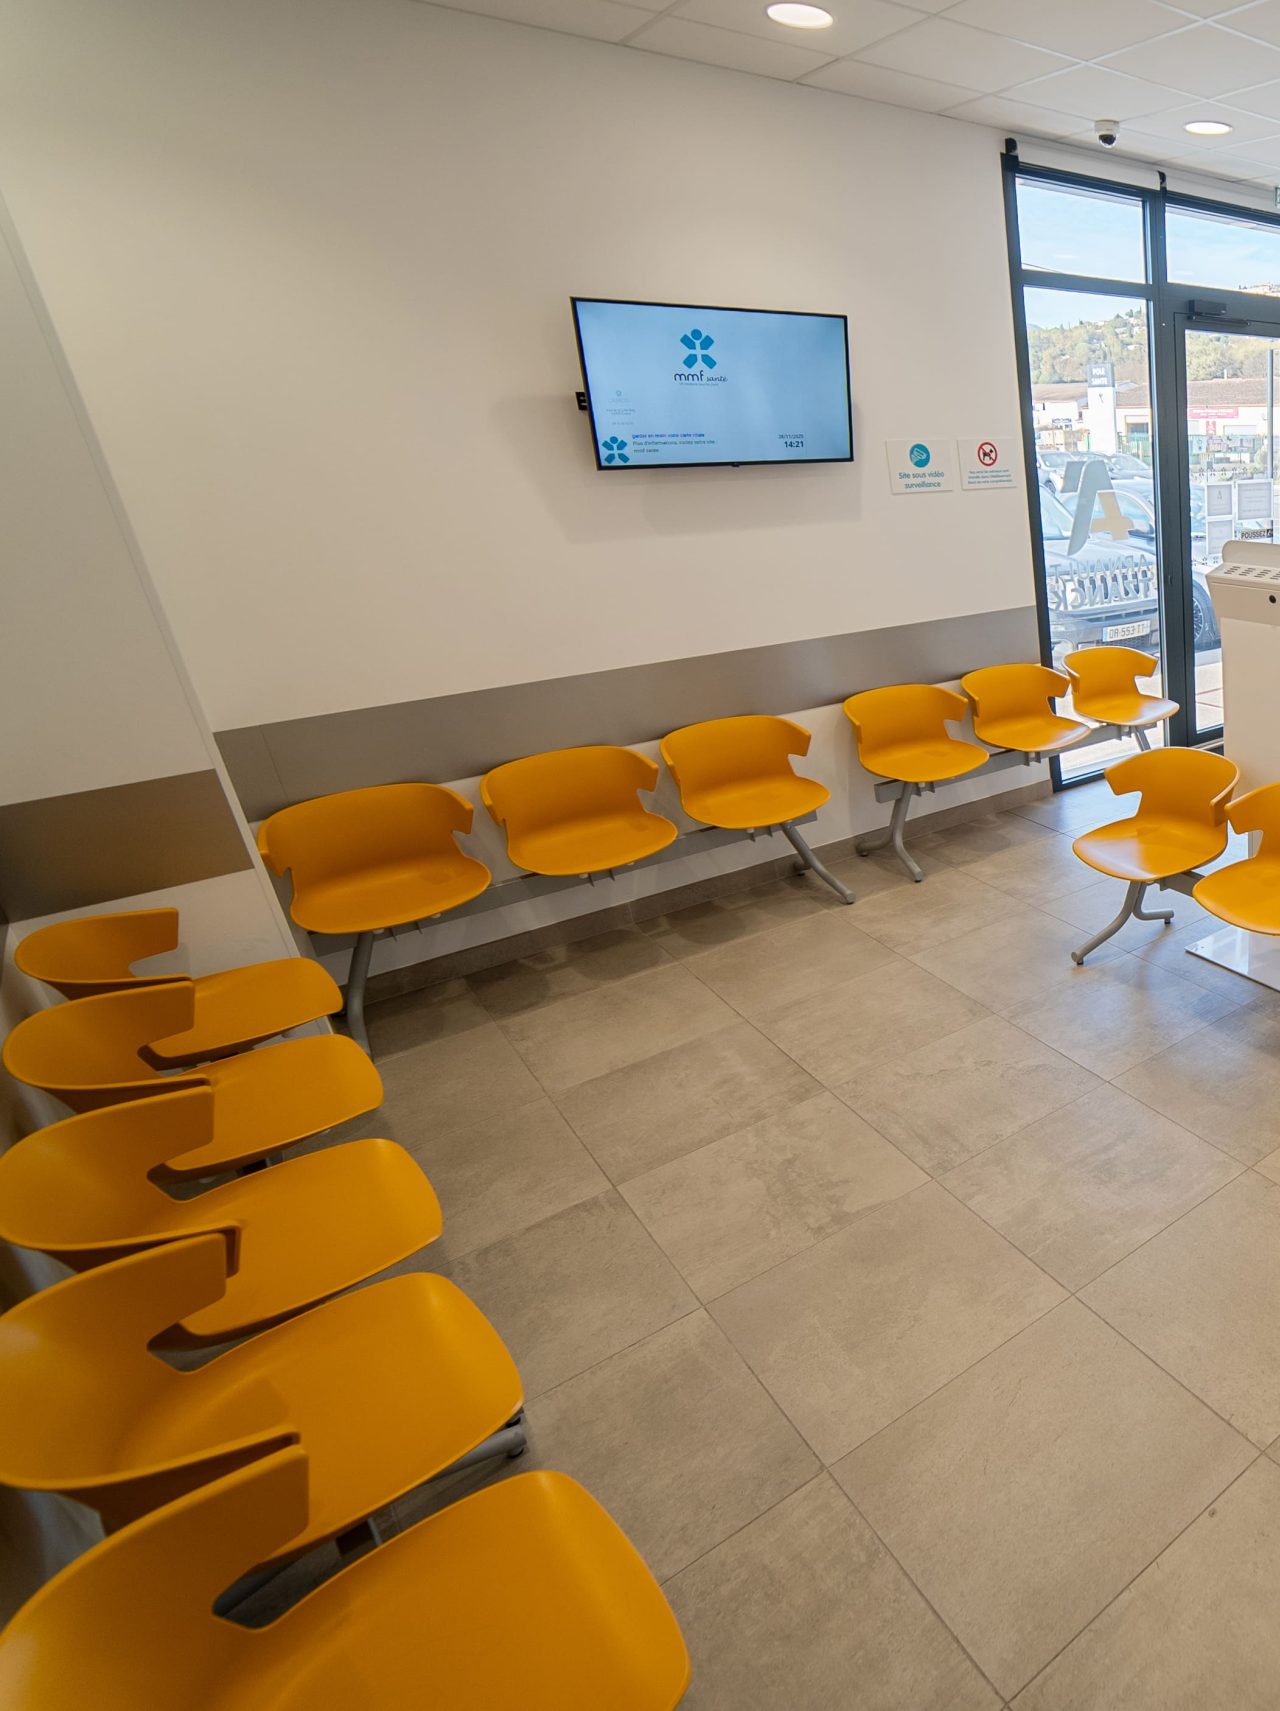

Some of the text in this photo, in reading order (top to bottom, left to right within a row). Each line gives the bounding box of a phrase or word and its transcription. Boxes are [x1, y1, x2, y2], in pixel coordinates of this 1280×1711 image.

[673, 370, 704, 381] mmf
[898, 472, 911, 480] Site
[928, 470, 945, 478] vidéo
[904, 480, 942, 489] surveillance
[1241, 529, 1266, 540] POUSSEZ
